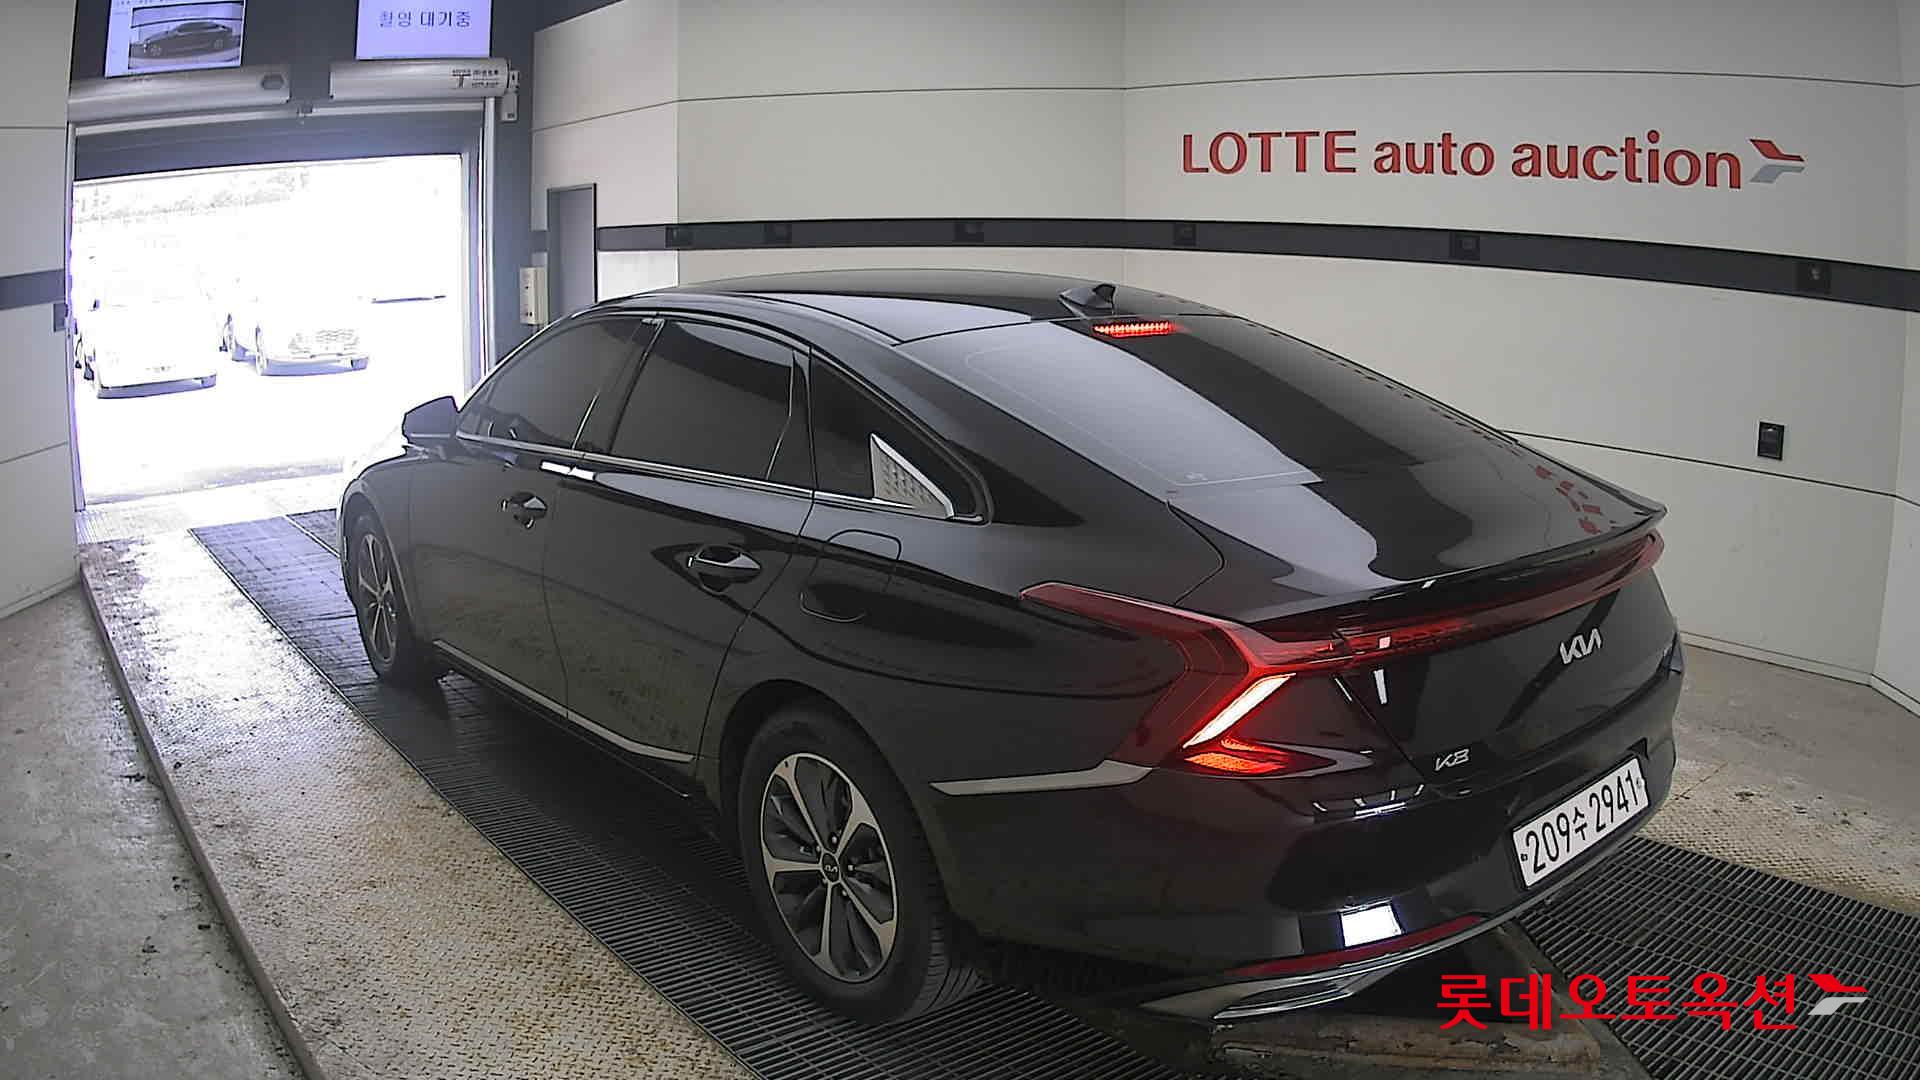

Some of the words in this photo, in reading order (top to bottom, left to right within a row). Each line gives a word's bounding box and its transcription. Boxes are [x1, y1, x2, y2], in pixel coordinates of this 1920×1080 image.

[420, 11, 471, 28] 대기중
[1183, 130, 1357, 174] LOTTE
[1373, 133, 1495, 177] auto
[1511, 130, 1741, 189] auction
[1559, 628, 1602, 665] KIA
[1433, 748, 1470, 772] K8
